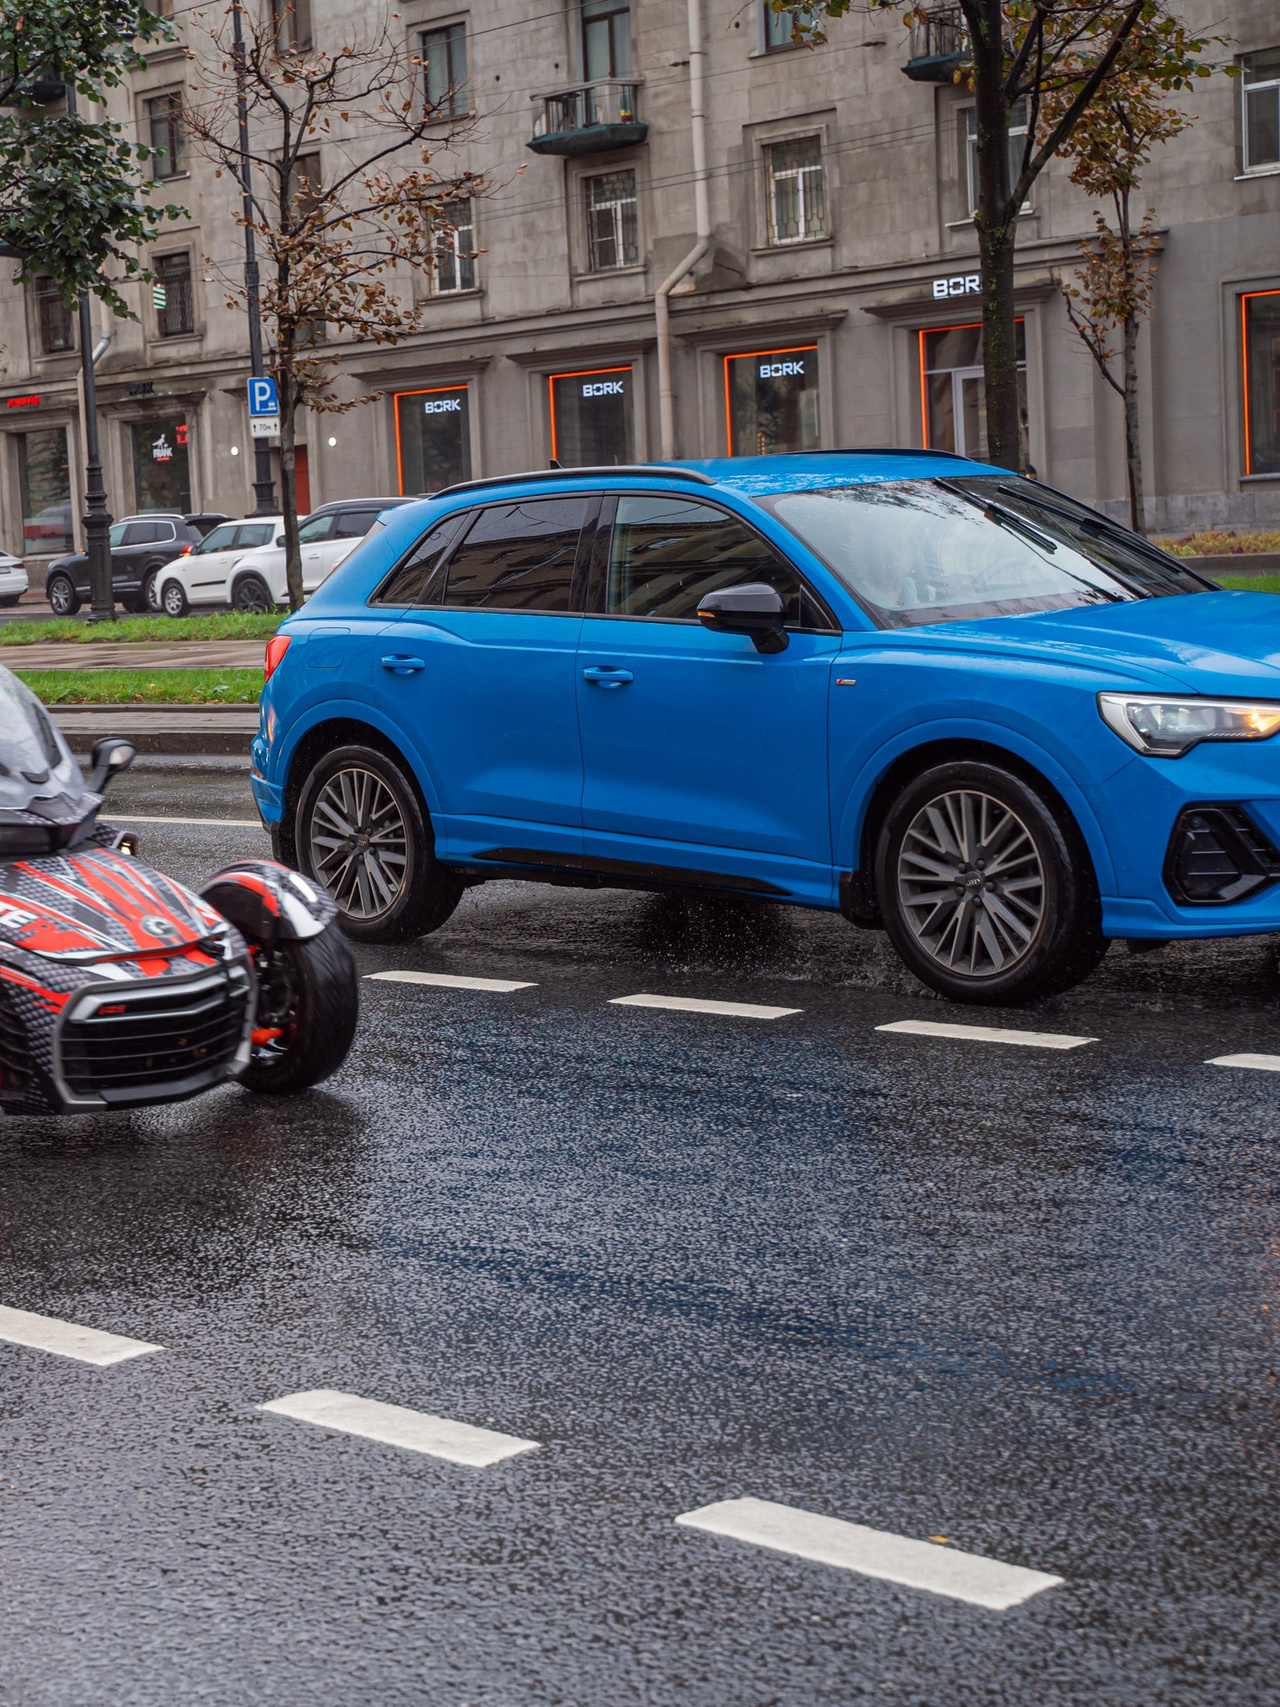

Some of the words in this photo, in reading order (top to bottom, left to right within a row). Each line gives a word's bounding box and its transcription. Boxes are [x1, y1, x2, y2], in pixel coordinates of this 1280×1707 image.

[932, 274, 983, 298] BOR
[759, 360, 805, 379] BORK
[582, 380, 624, 397] BORK
[424, 398, 461, 414] BORK
